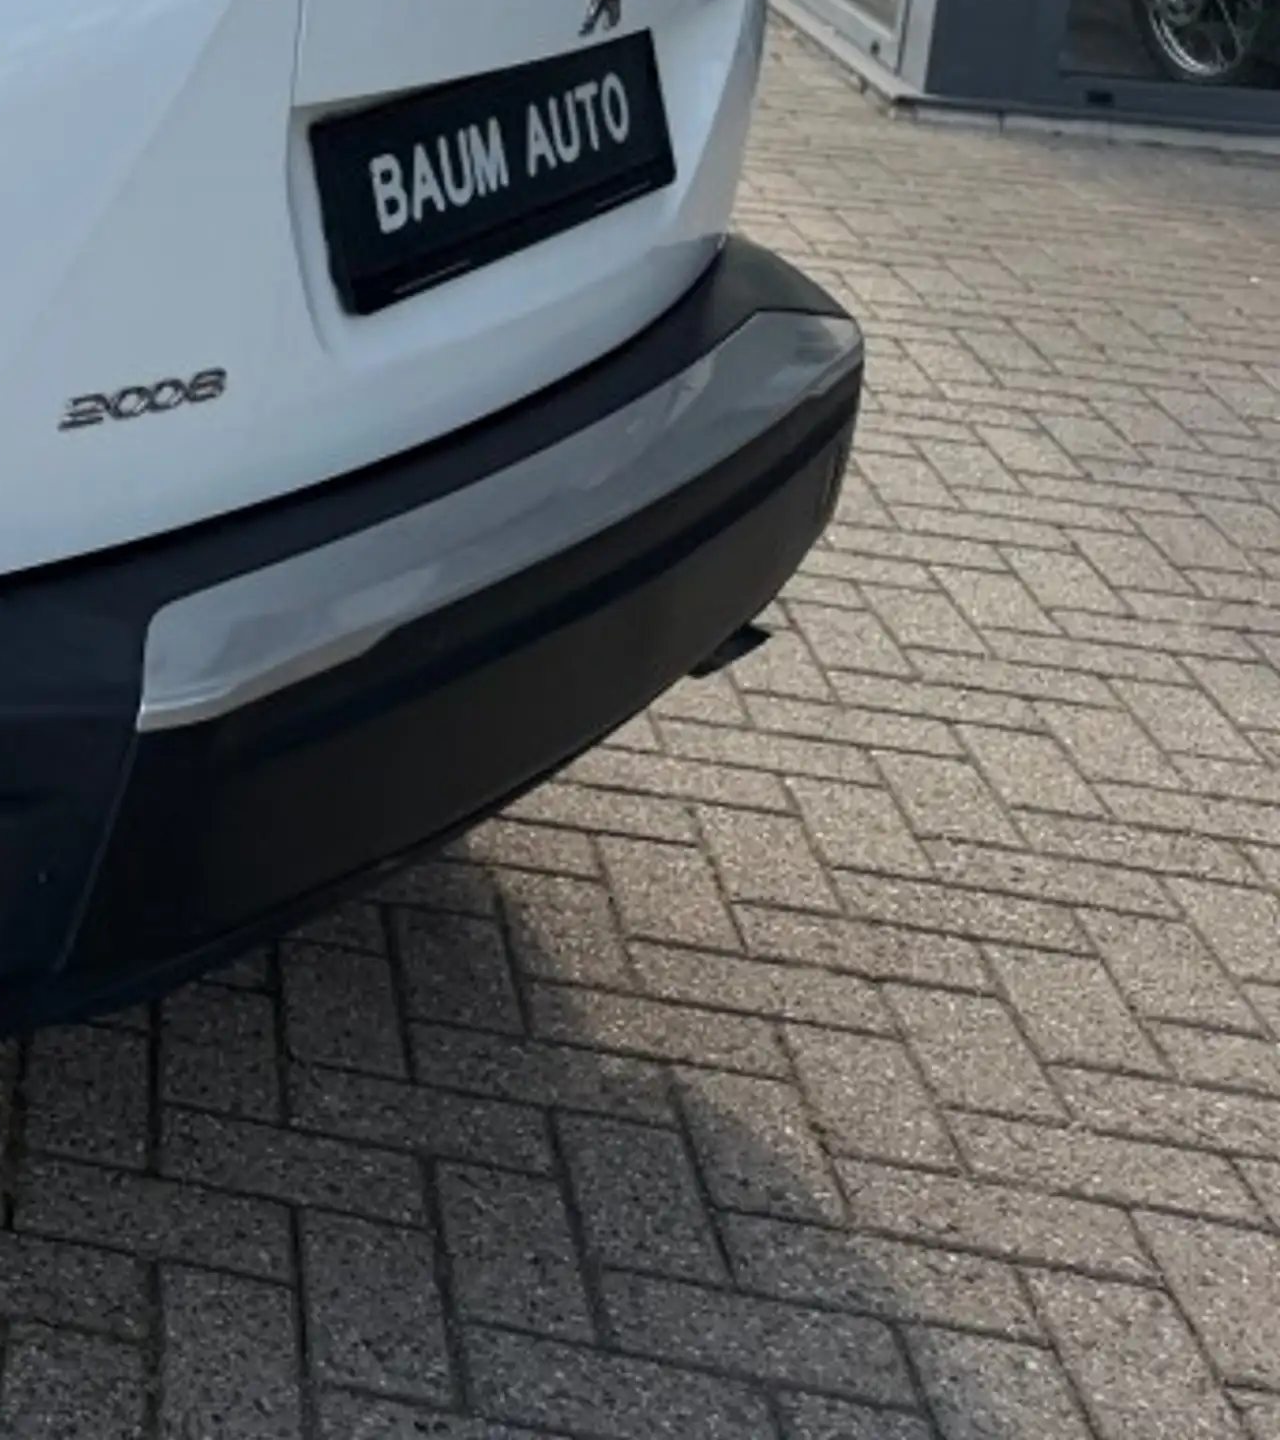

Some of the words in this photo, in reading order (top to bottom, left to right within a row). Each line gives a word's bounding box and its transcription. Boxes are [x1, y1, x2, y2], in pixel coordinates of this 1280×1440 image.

[369, 116, 509, 234] BAUM
[526, 72, 630, 178] AUTO
[57, 366, 227, 432] 2008
